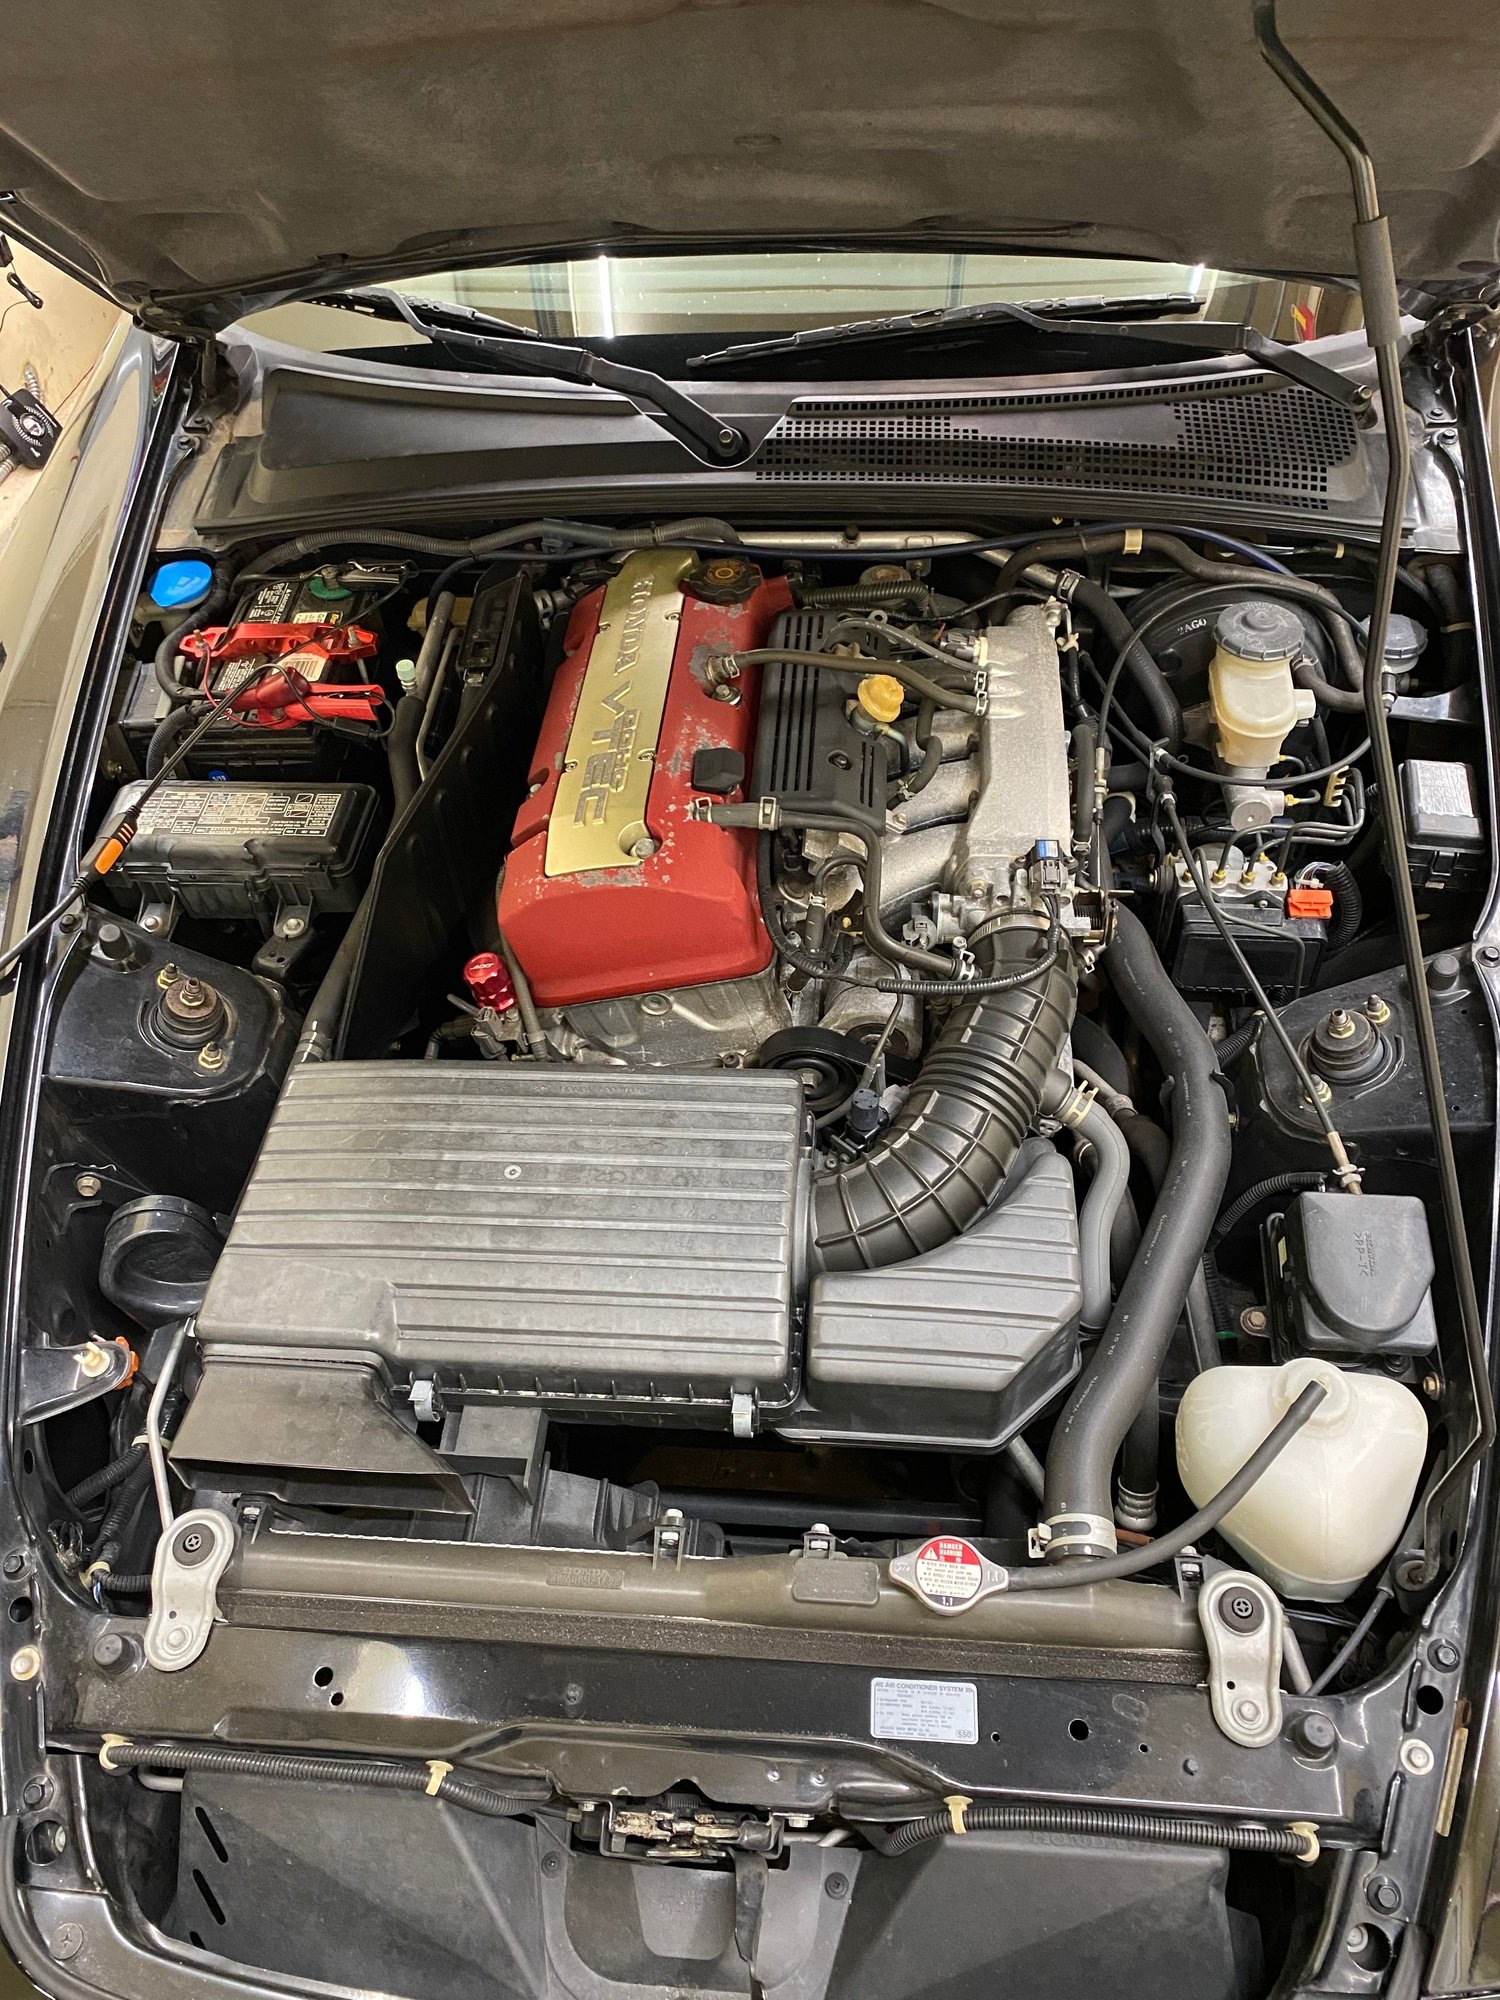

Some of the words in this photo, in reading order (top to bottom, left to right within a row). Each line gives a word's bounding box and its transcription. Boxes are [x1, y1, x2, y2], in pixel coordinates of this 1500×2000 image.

[614, 575, 654, 676] HONDA
[573, 680, 632, 827] VTEC
[941, 1596, 954, 1606] 1.1
[896, 1682, 938, 1691] CONDITIONER
[938, 1685, 964, 1693] SYSTEM
